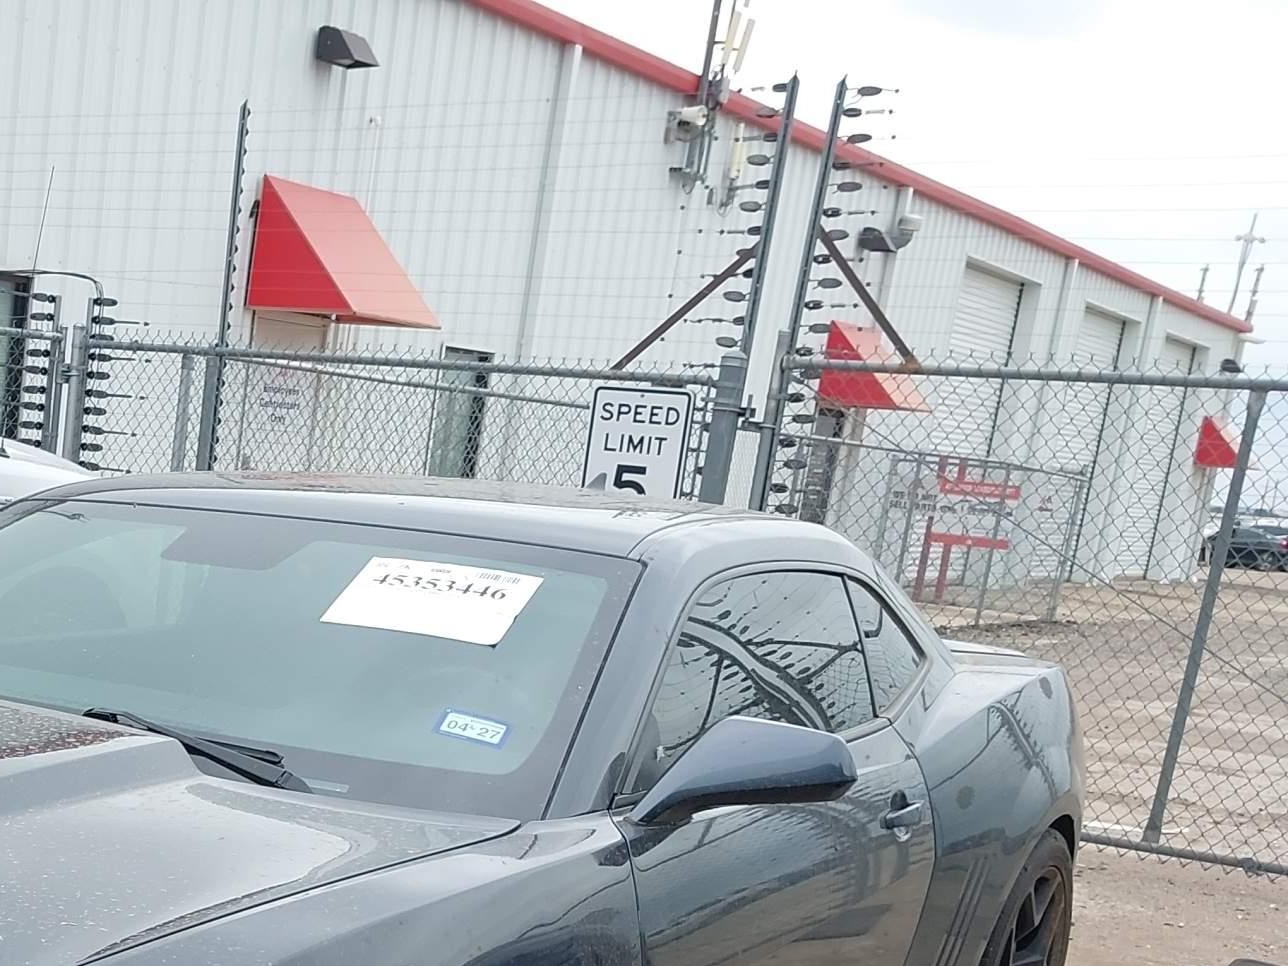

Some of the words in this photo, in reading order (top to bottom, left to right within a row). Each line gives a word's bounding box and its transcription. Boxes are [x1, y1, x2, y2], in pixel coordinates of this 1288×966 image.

[599, 402, 681, 426] SPEED
[603, 433, 668, 456] LIMIT
[613, 464, 647, 496] 5
[372, 573, 507, 600] 45353446
[447, 719, 469, 732] 04
[476, 727, 501, 739] 27
